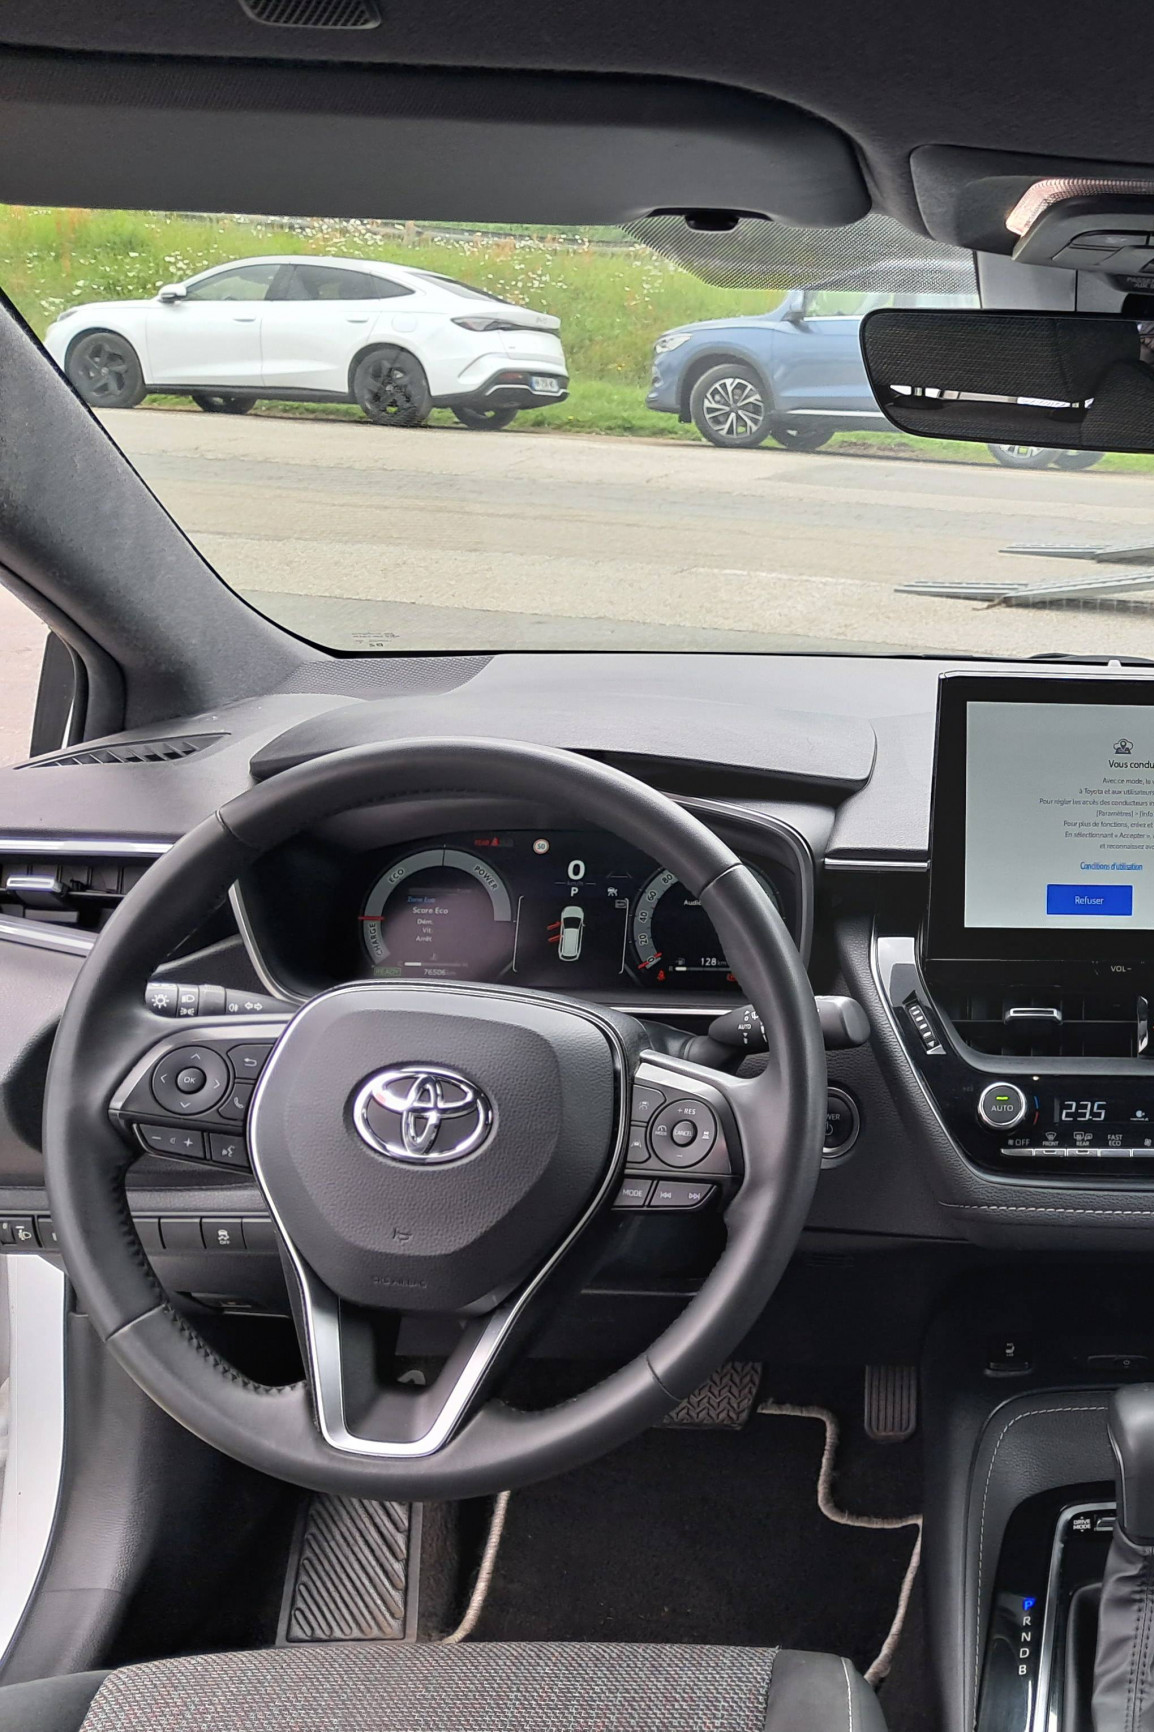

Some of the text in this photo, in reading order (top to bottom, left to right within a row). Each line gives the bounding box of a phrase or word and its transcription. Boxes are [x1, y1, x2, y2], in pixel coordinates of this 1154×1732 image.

[1108, 759, 1129, 769] Vous
[1084, 788, 1103, 797] Toyota
[567, 859, 586, 880] 0
[1080, 862, 1143, 871] Conditions d'utilisation
[388, 868, 405, 884] ECO
[474, 865, 498, 891] POWER
[662, 874, 673, 884] 80
[570, 887, 579, 897] P
[647, 890, 657, 902] 60
[1074, 896, 1104, 905] Refuser
[412, 906, 449, 915] Score Eco
[639, 911, 648, 924] 40
[370, 922, 383, 956] CHARGE
[639, 934, 648, 946] 20
[700, 958, 717, 966] 128
[423, 968, 446, 976] 76506
[183, 1075, 197, 1084] OK
[684, 1107, 696, 1115] RES
[990, 1104, 1014, 1112] AUTO
[674, 1129, 692, 1137] CANCEL
[1015, 1138, 1030, 1146] OFF
[622, 1189, 643, 1197] MODE
[1023, 1598, 1035, 1611] P
[1023, 1616, 1032, 1626] R
[1021, 1632, 1031, 1642] N
[1019, 1647, 1030, 1658] D
[1018, 1665, 1027, 1675] B
